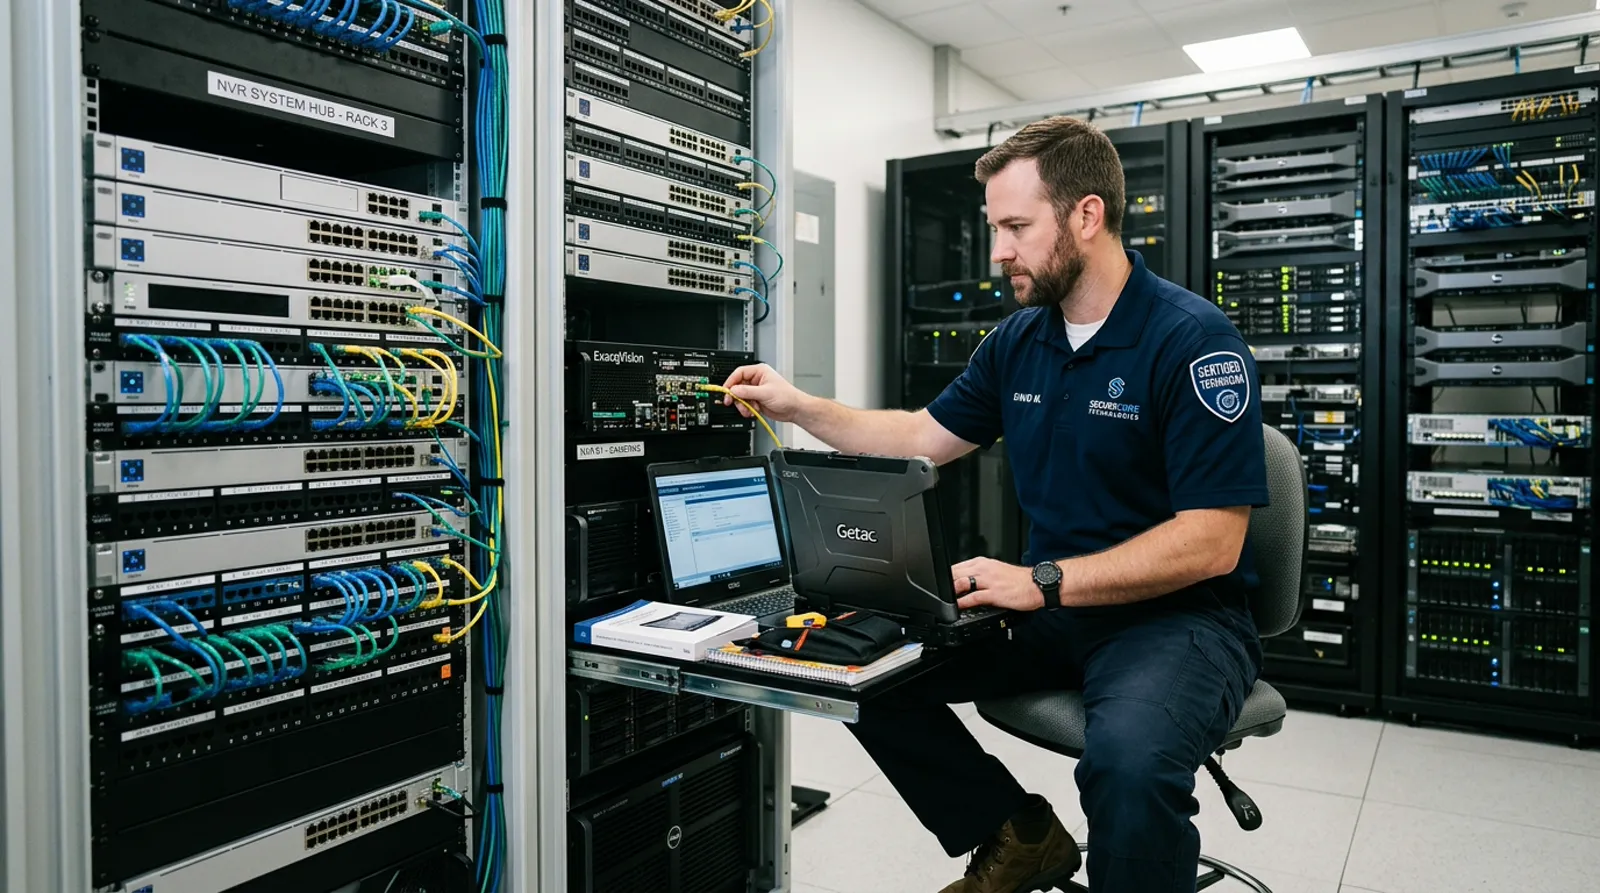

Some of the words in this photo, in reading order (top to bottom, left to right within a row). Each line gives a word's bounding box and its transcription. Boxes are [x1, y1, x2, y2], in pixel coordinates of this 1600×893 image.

[217, 79, 247, 97] NVR
[250, 87, 306, 112] SYSTEM
[308, 101, 335, 118] HUB
[345, 111, 378, 129] RACK
[380, 120, 388, 131] 3
[836, 523, 878, 543] Getac
